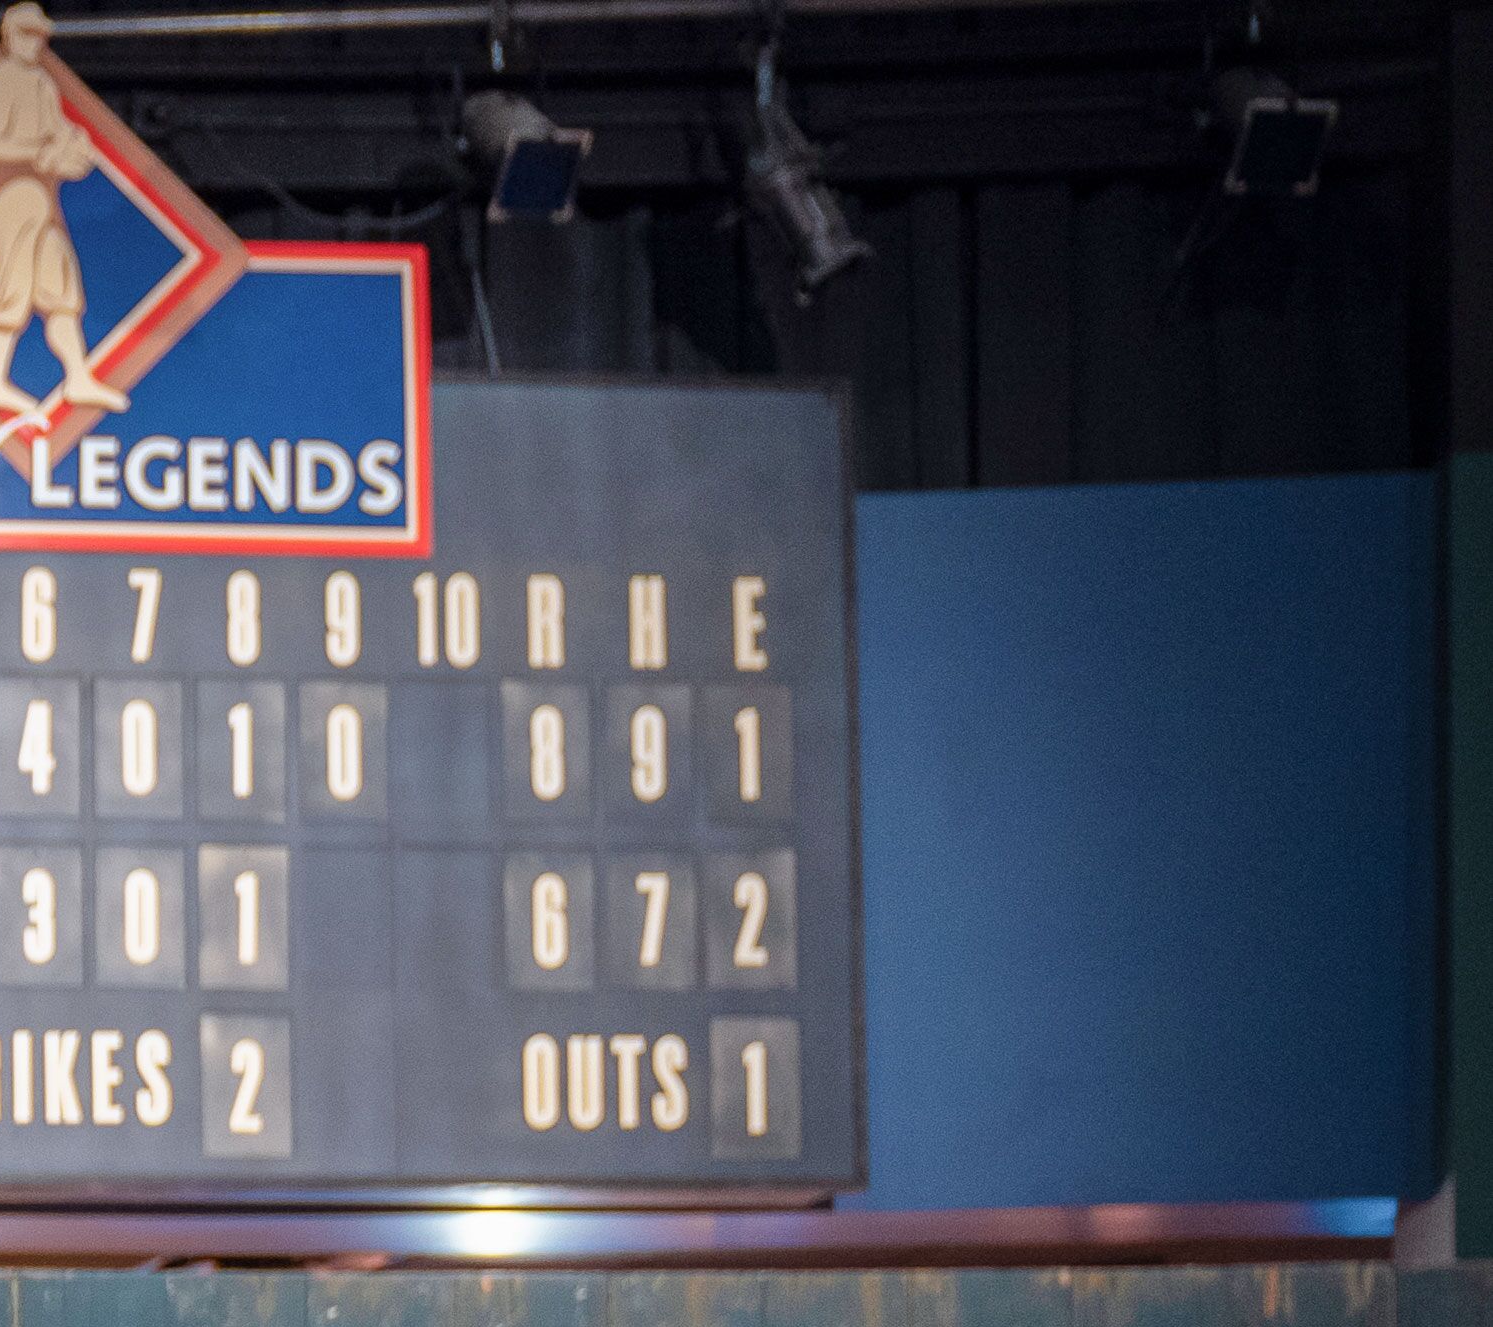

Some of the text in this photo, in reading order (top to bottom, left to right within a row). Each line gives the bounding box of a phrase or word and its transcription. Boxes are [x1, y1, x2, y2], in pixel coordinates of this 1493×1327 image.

[29, 435, 403, 516] LEGENDS
[21, 566, 56, 663] 6
[128, 567, 163, 664] 7
[226, 569, 261, 667] 8
[326, 569, 362, 668] 9
[413, 571, 480, 669] 10
[527, 572, 565, 669] R
[629, 574, 667, 671] H
[733, 575, 768, 672] E
[18, 699, 54, 795] 4
[122, 698, 157, 796] 0
[227, 702, 254, 798] 1
[326, 704, 363, 801] 0
[529, 704, 566, 801] 8
[631, 705, 667, 802] 9
[734, 706, 761, 802] 1
[22, 867, 57, 965] 3
[124, 867, 160, 965] 0
[234, 870, 261, 967] 1
[531, 872, 569, 969] 6
[635, 872, 670, 967] 7
[733, 872, 768, 968] 2
[229, 1038, 265, 1135] 2
[522, 1033, 688, 1131] OUTS
[742, 1040, 768, 1137] 1
